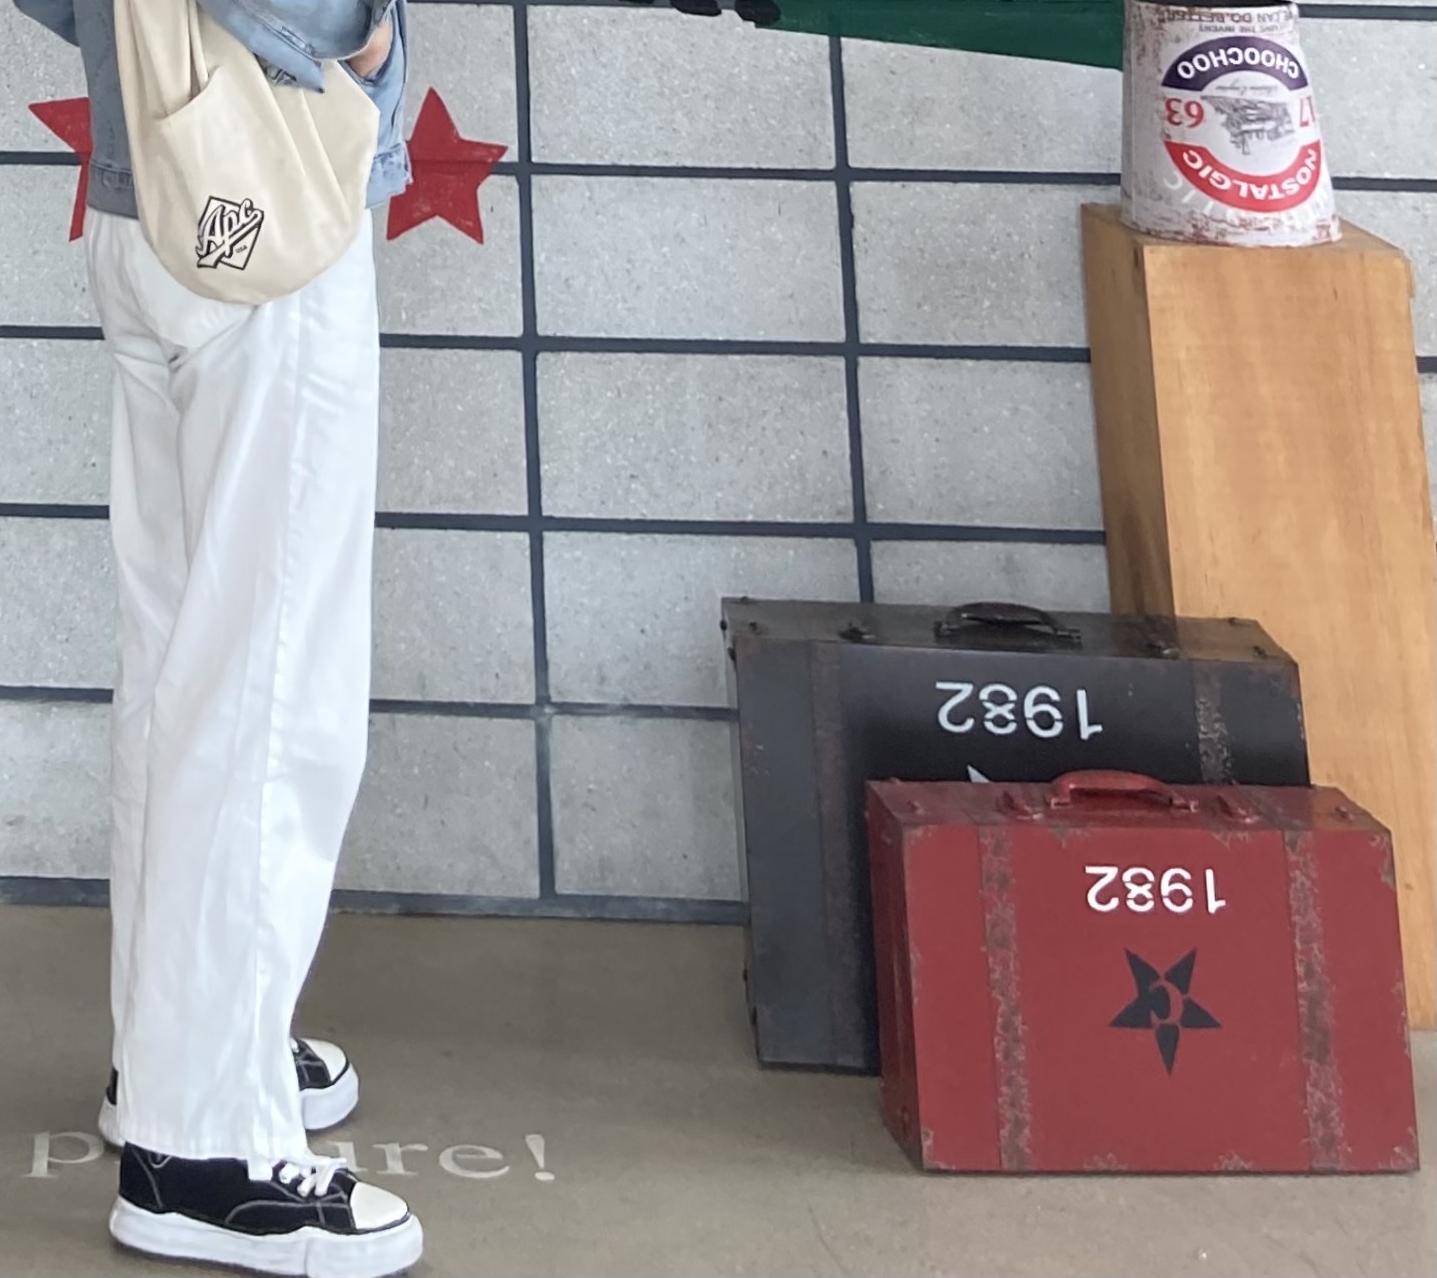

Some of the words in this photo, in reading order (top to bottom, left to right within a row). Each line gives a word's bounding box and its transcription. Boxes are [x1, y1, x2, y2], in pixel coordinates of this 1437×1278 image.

[1177, 47, 1299, 79] CHOOCHOO
[1165, 97, 1204, 128] 63
[1182, 148, 1319, 201] NOSTALGIC
[935, 681, 1103, 741] 1982
[1084, 865, 1227, 914] 1982
